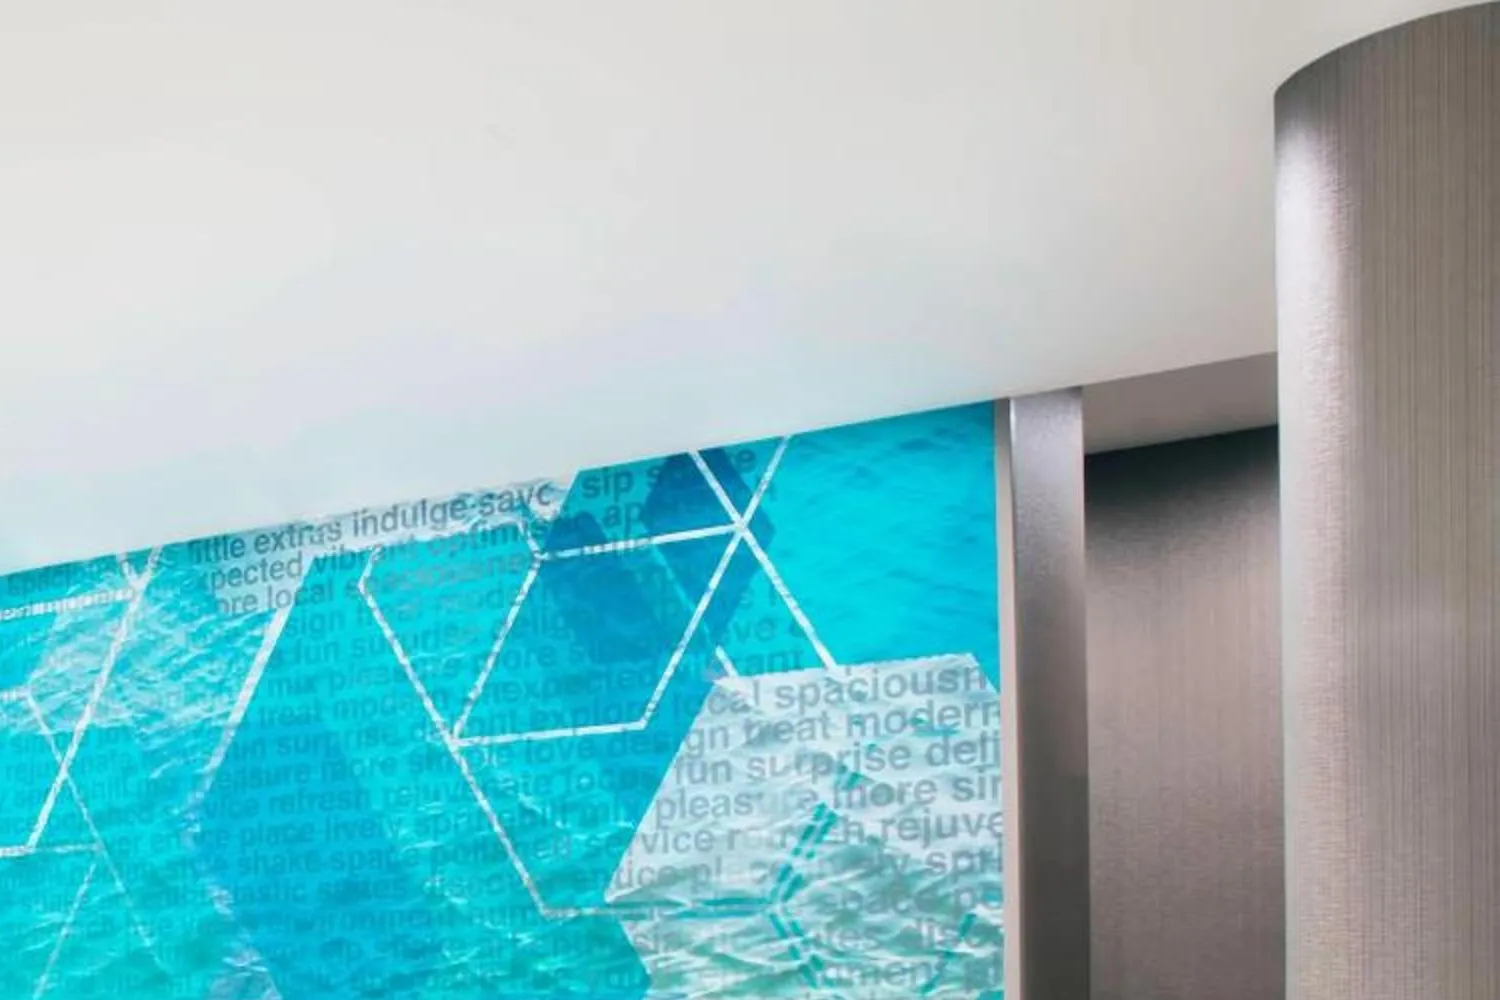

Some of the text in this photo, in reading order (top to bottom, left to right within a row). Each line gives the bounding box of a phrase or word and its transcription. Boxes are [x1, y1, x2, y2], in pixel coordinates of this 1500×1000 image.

[352, 497, 467, 536] indulge
[582, 466, 634, 502] sip
[267, 574, 334, 610] local
[746, 742, 911, 786] surprise
